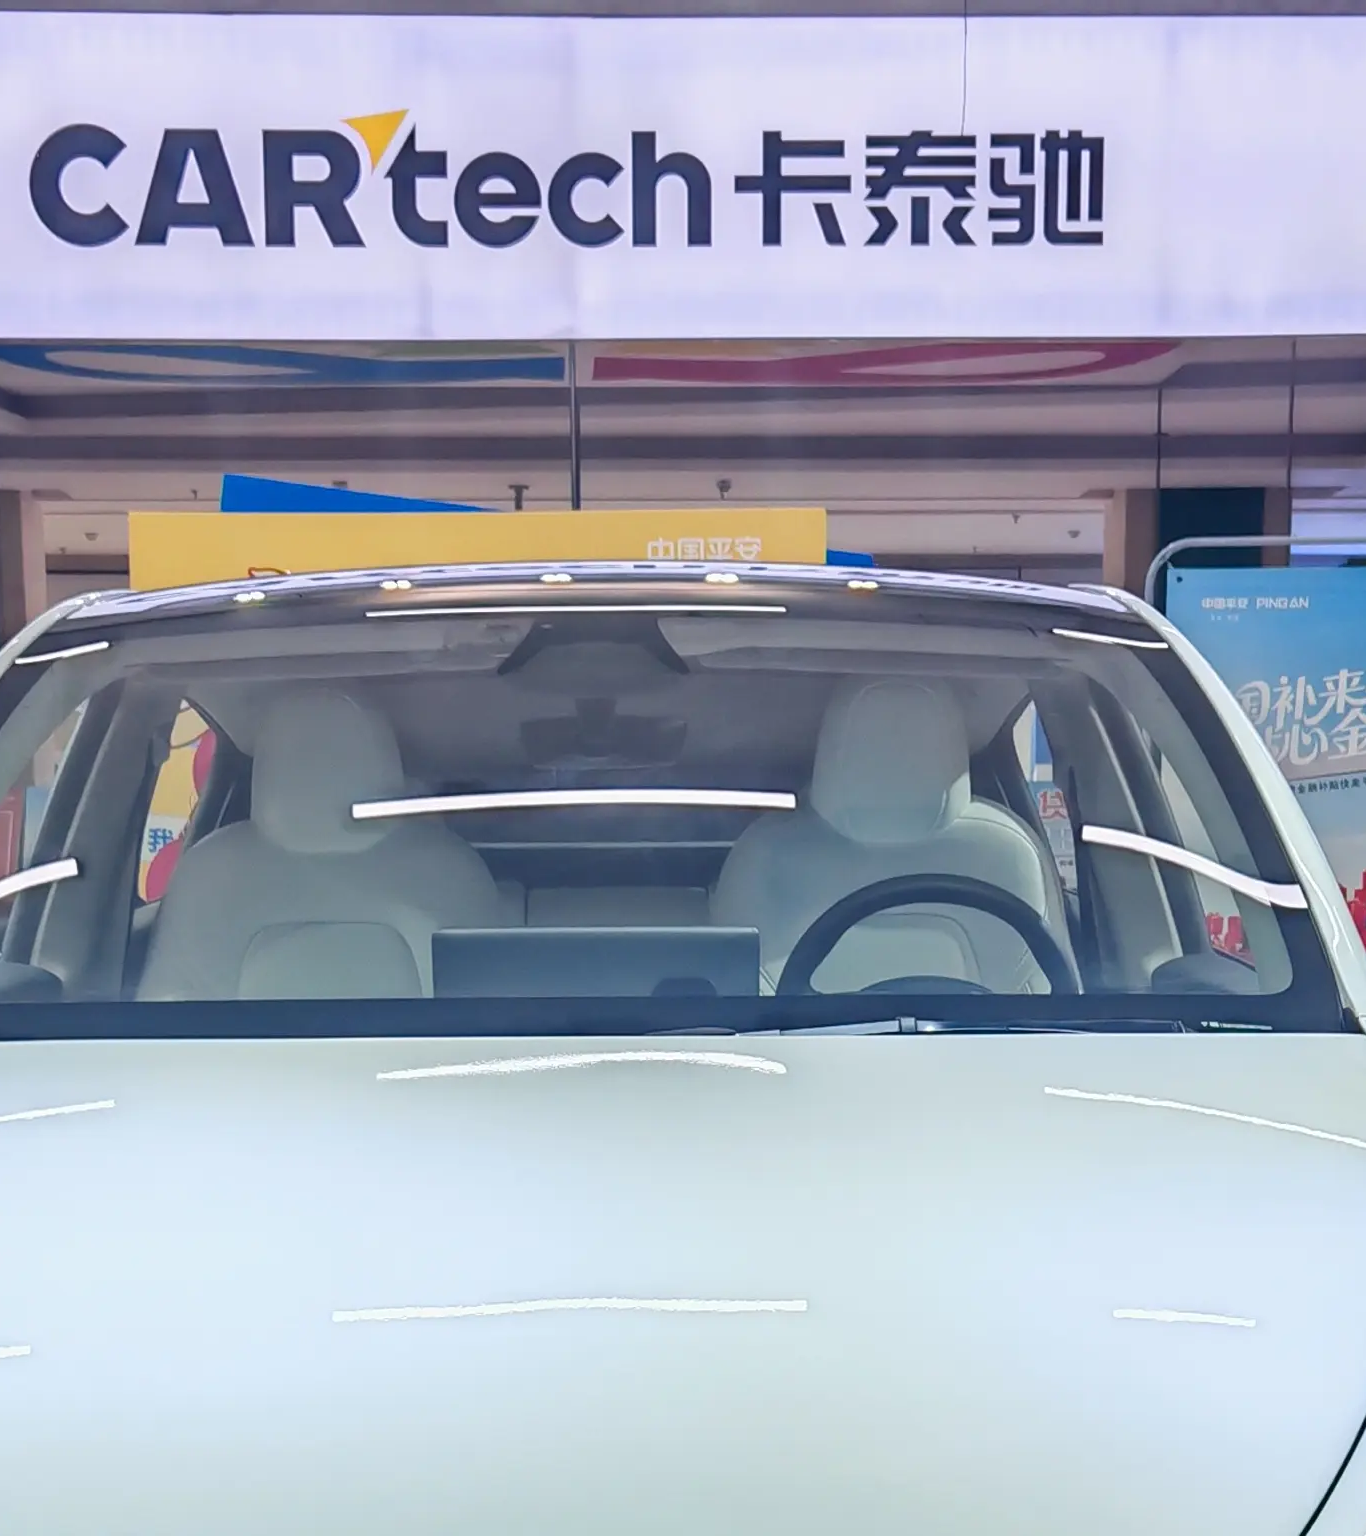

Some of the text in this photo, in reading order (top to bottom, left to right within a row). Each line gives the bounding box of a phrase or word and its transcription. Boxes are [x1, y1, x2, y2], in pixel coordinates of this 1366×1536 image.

[29, 122, 1104, 249] CARtech 卡泰驰
[647, 537, 763, 561] 中国平安
